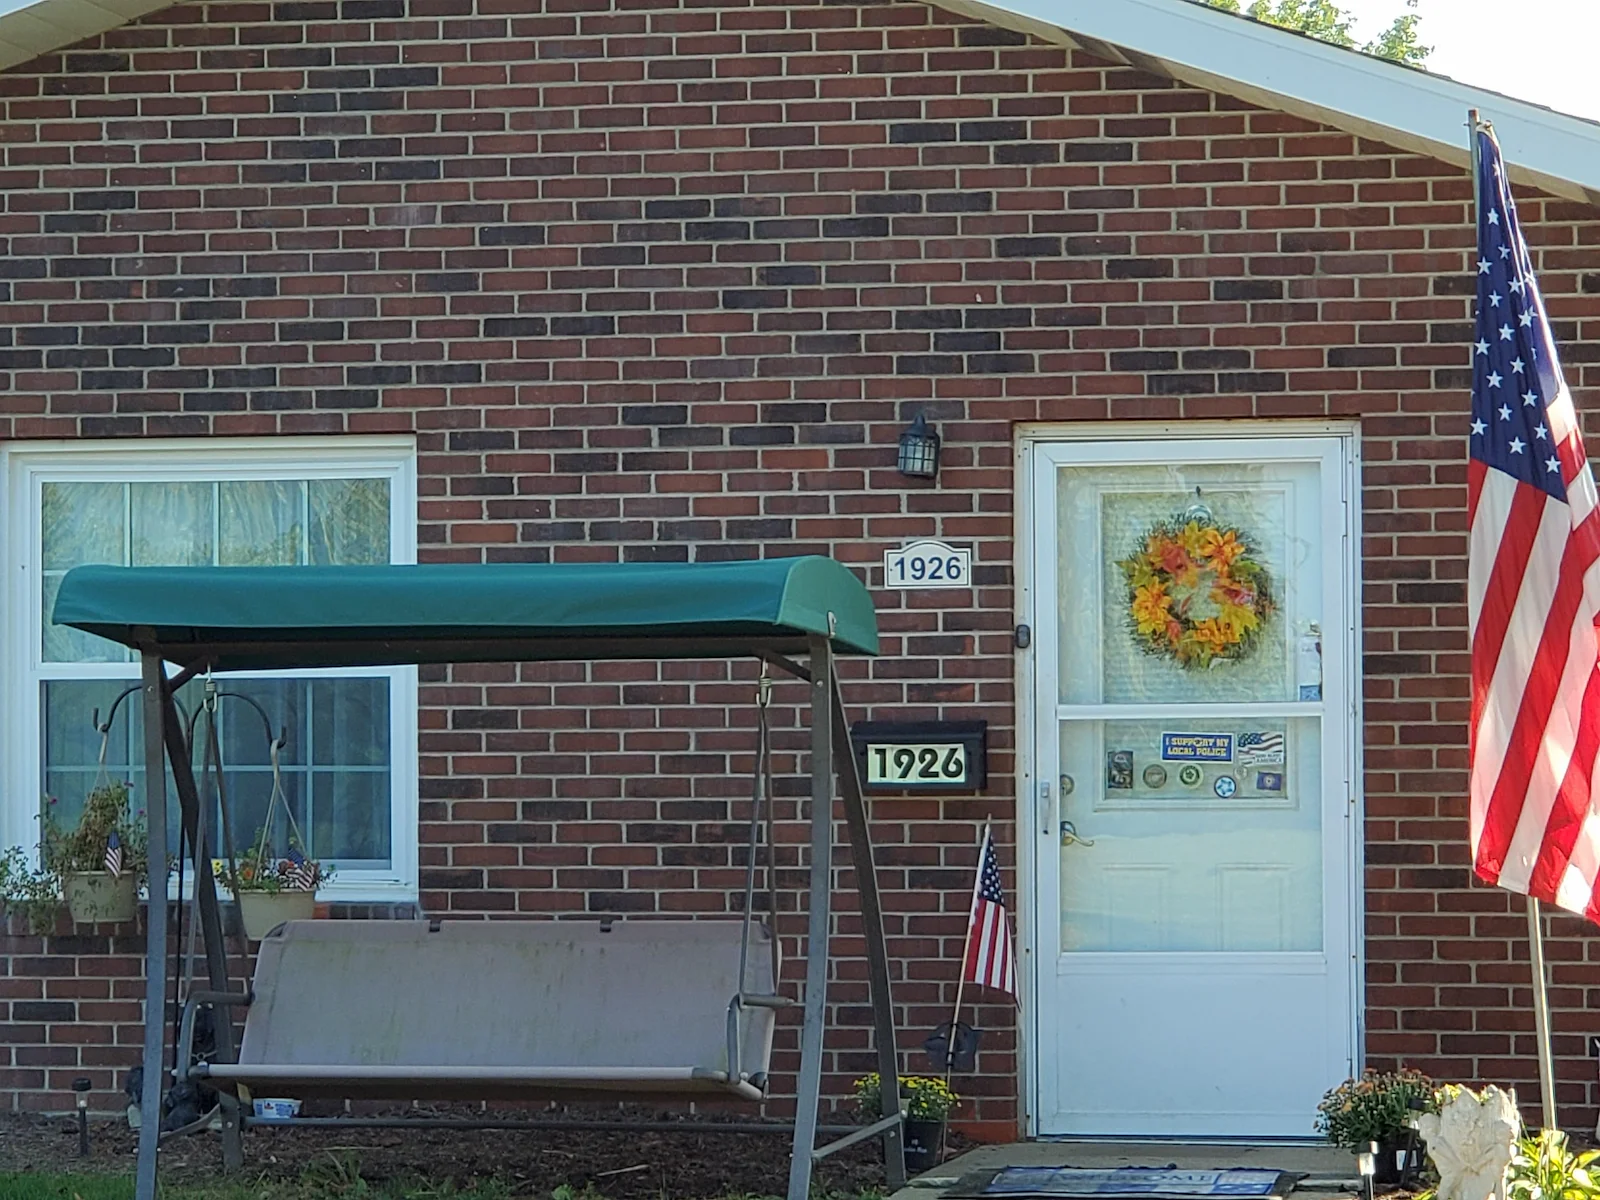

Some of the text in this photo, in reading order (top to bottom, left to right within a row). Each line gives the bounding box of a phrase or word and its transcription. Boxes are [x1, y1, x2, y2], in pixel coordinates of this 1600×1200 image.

[894, 557, 961, 580] 1926
[1171, 737, 1214, 747] SUPPORT
[1216, 738, 1229, 747] MY
[1168, 747, 1226, 756] LOCAL POLICE
[874, 748, 963, 778] 1926
